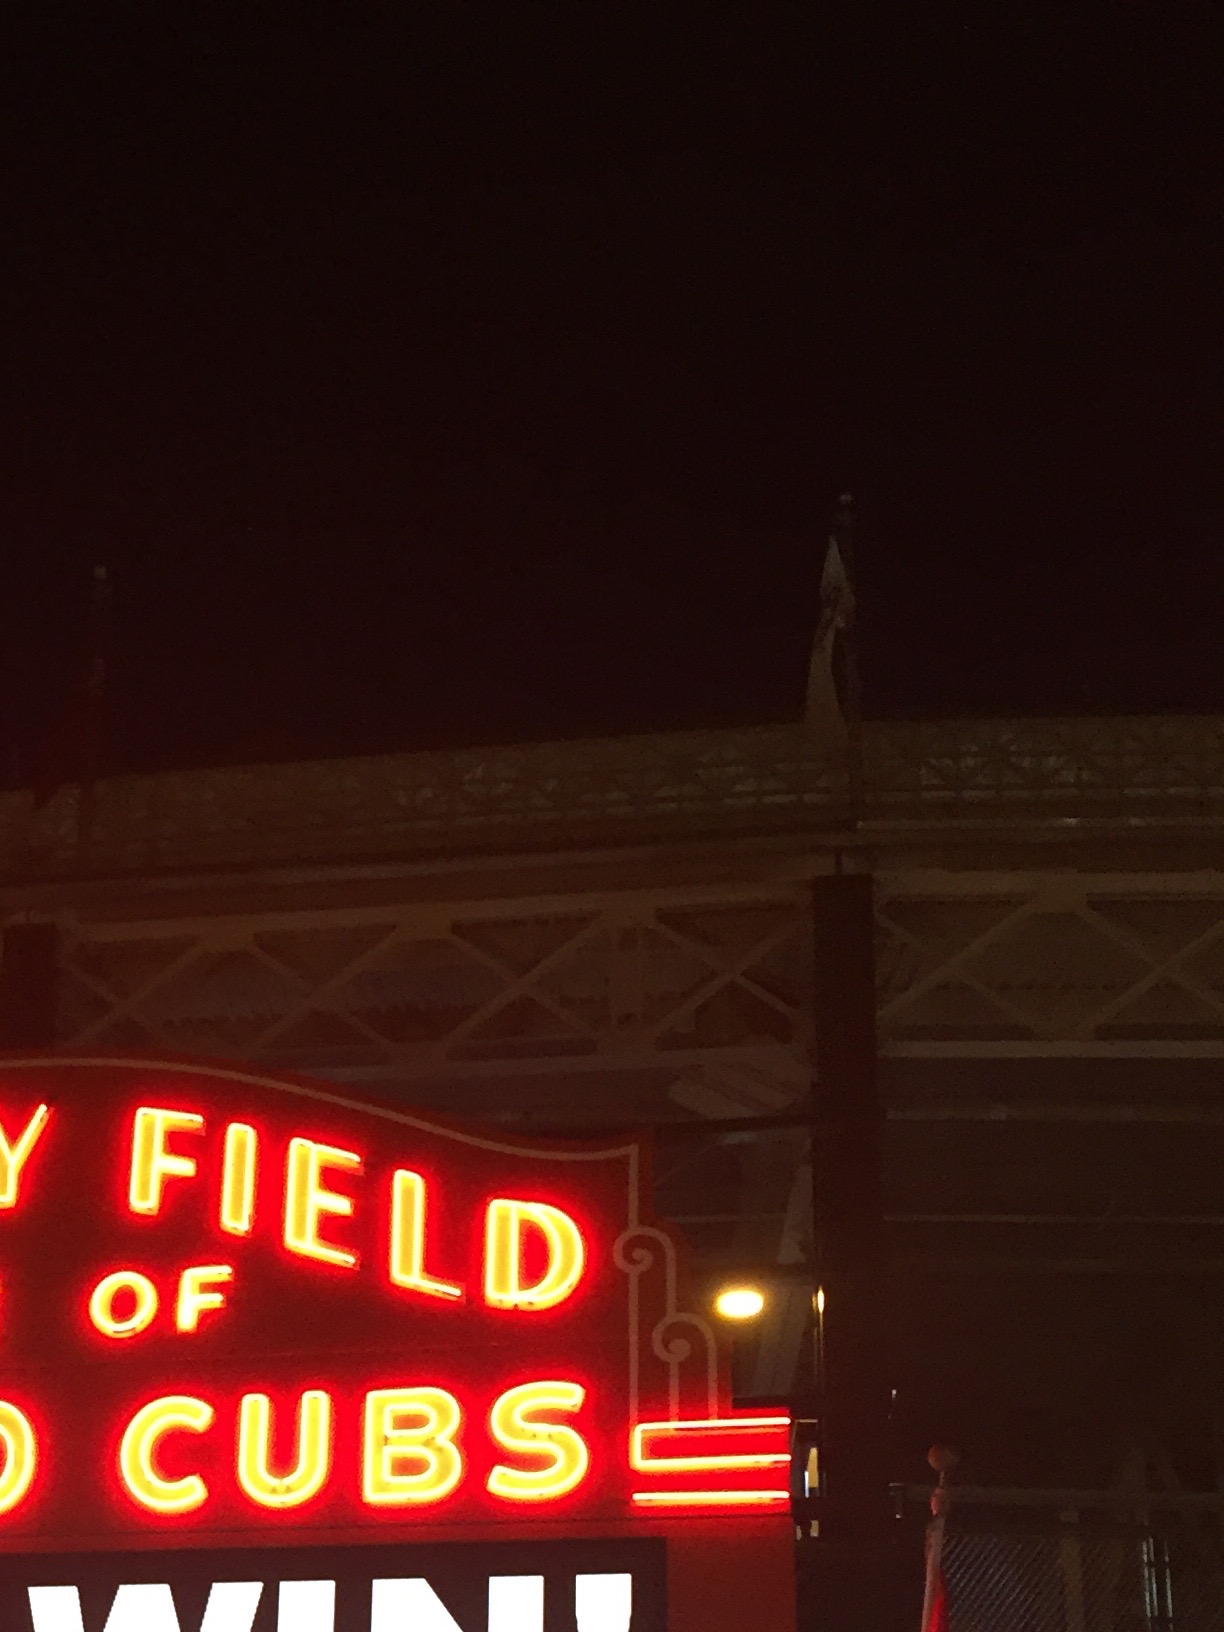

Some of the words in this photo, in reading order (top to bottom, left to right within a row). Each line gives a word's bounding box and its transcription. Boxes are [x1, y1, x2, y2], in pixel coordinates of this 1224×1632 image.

[128, 1106, 585, 1312] FIELD
[88, 1264, 234, 1339] OF
[119, 1380, 589, 1515] CUBS
